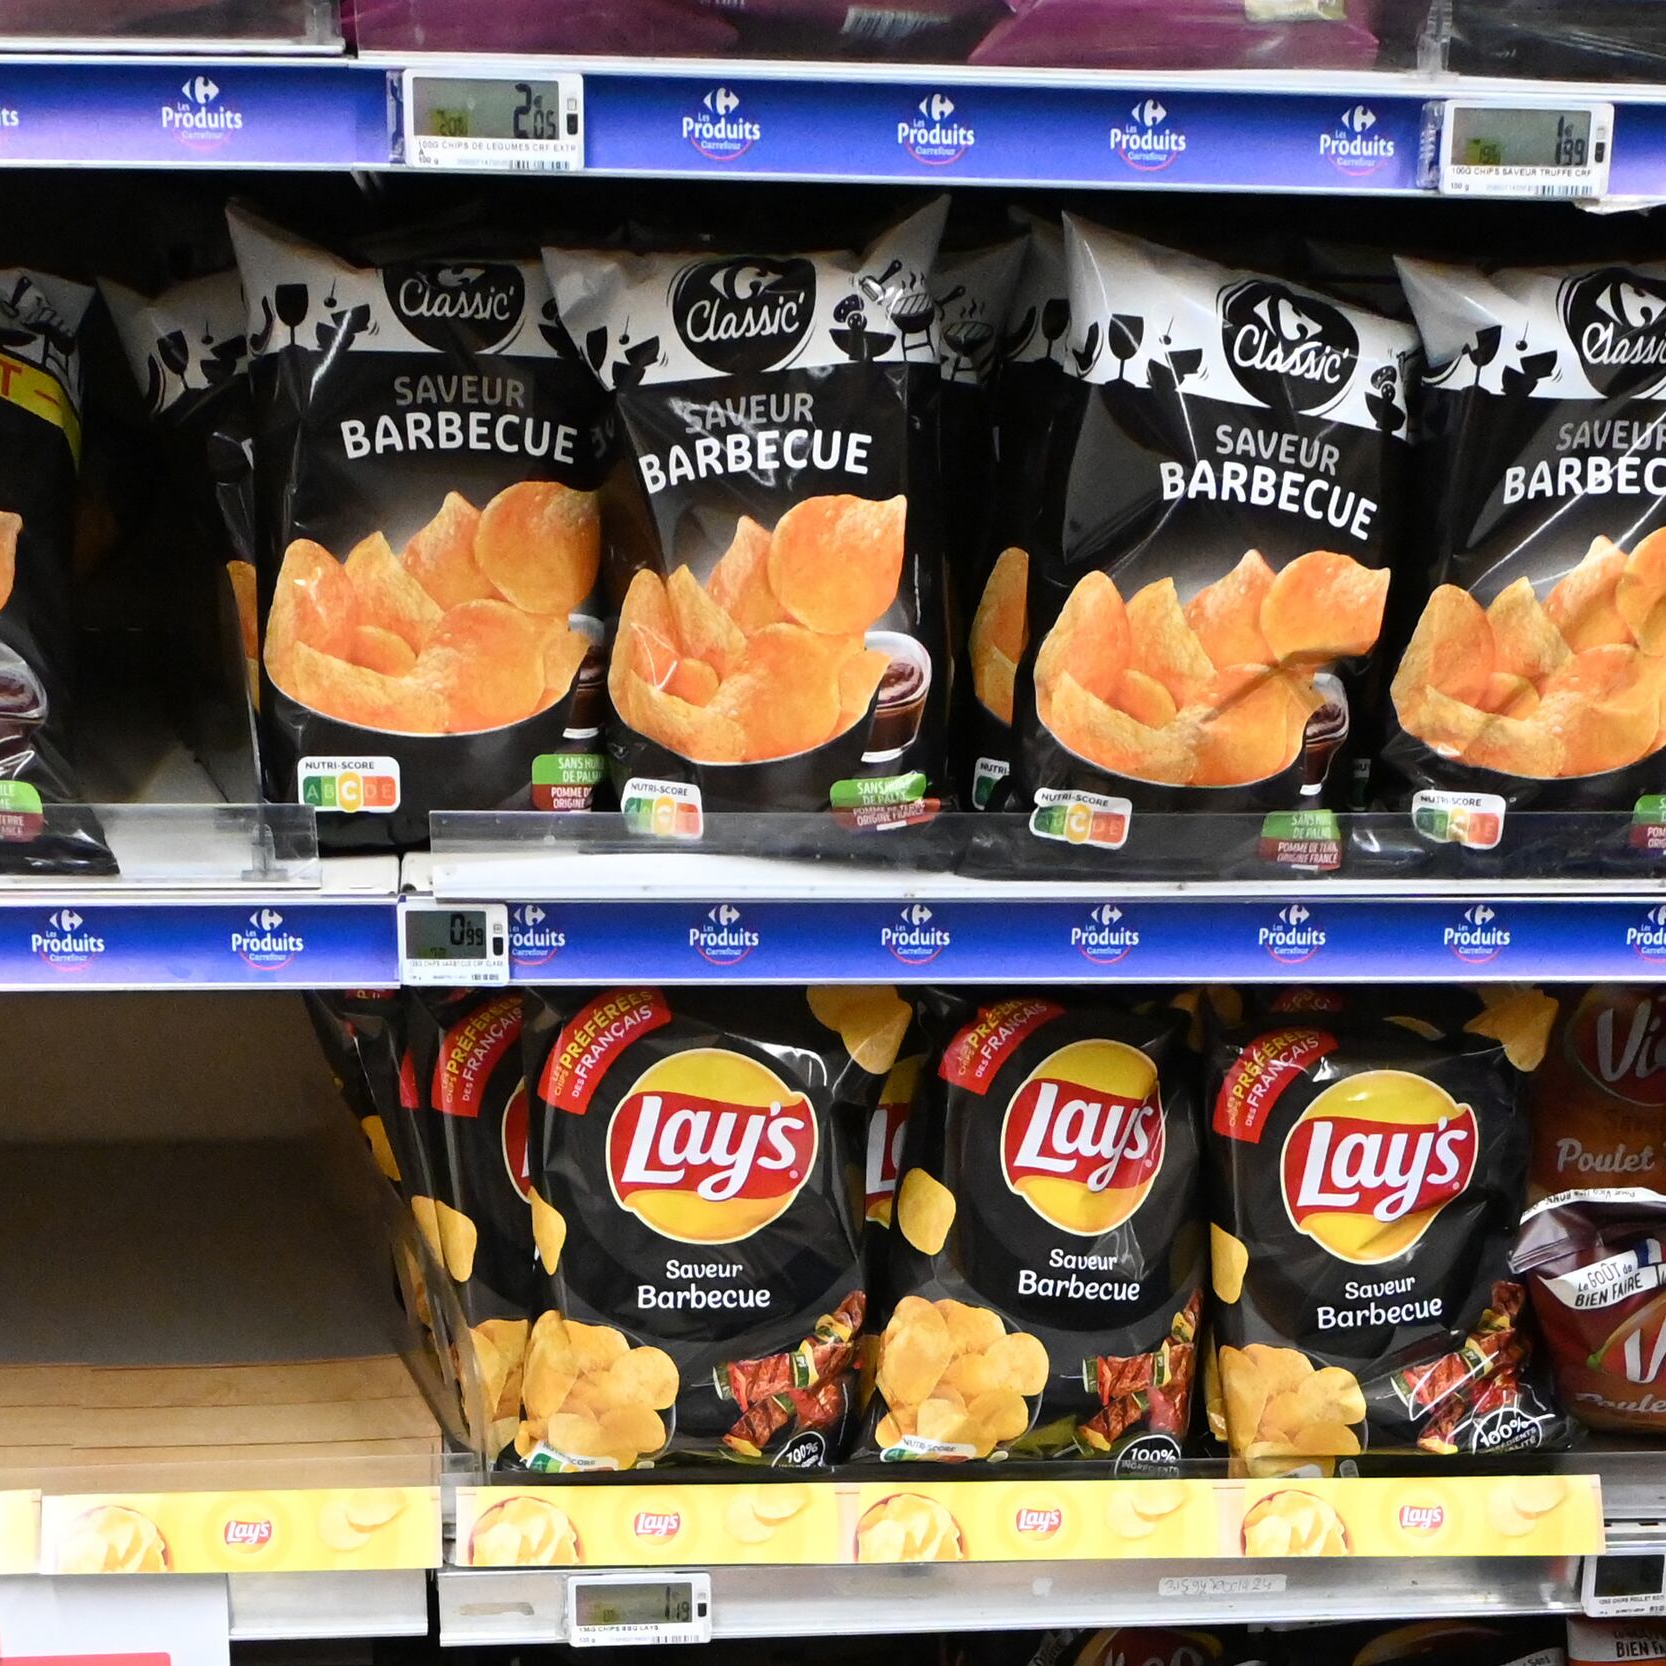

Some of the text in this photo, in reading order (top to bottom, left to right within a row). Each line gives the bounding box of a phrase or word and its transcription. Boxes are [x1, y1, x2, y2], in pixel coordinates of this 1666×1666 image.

[161, 105, 243, 133] Produits
[682, 115, 762, 143] Produits
[394, 376, 525, 408] SAVEUR
[340, 411, 578, 466] BARBECUE
[1215, 423, 1341, 475] SAVEUR
[638, 429, 872, 496] BARBECUE
[1160, 460, 1378, 541] BARBECUE
[305, 760, 375, 772] NUTRI-SCORE
[1443, 925, 1511, 949] Produits
[563, 989, 653, 1068] PRÉFÉRÉES
[577, 1004, 652, 1082] FRANÇAIS
[621, 1095, 805, 1202] Lay's
[1014, 1084, 1156, 1192] Lay's
[1299, 1117, 1468, 1221] Lay's
[666, 1258, 743, 1280] Saveur
[1049, 1249, 1117, 1272] Saveur
[636, 1285, 771, 1311] Barbecue
[1017, 1270, 1140, 1301] Barbecue
[1344, 1275, 1415, 1300] Saveur
[1317, 1296, 1443, 1330] Barbecue
[1399, 1507, 1444, 1529] Lay's
